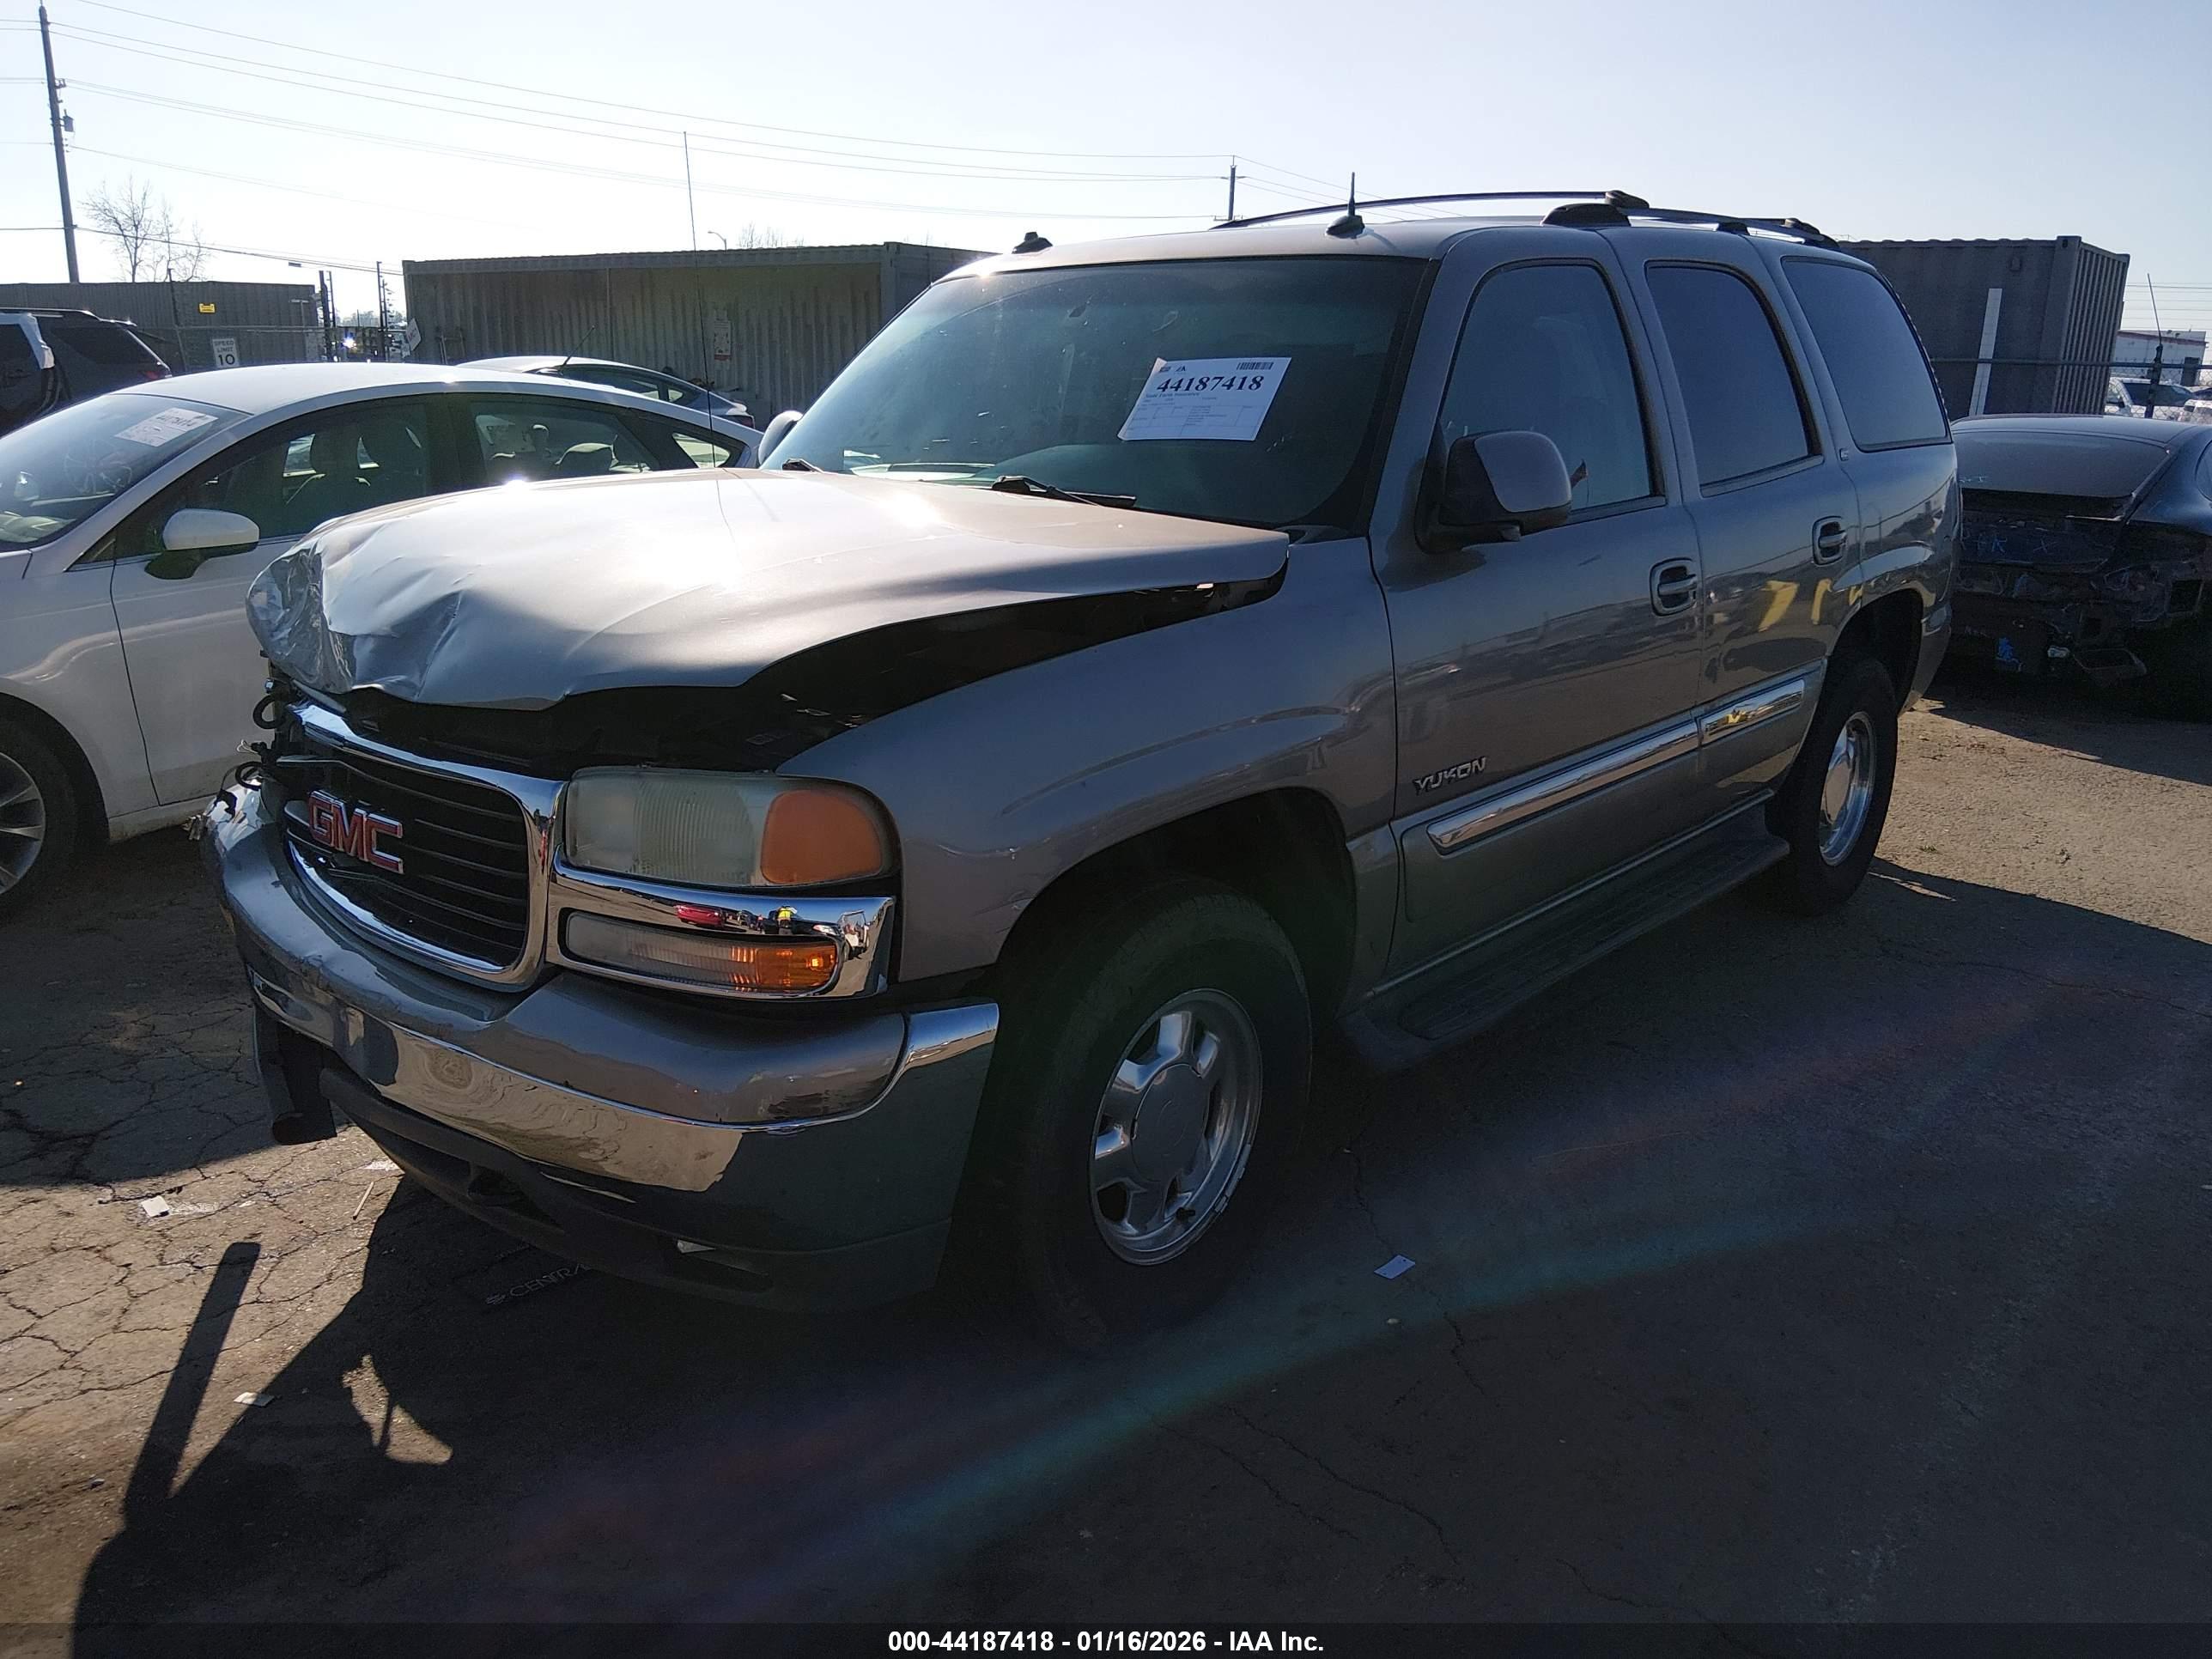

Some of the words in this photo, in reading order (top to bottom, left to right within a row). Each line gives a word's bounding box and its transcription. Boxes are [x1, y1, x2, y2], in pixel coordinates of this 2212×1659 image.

[218, 354, 235, 366] 10
[1157, 375, 1265, 392] 44187418
[1413, 756, 1487, 796] YUKON
[308, 789, 404, 875] GMC
